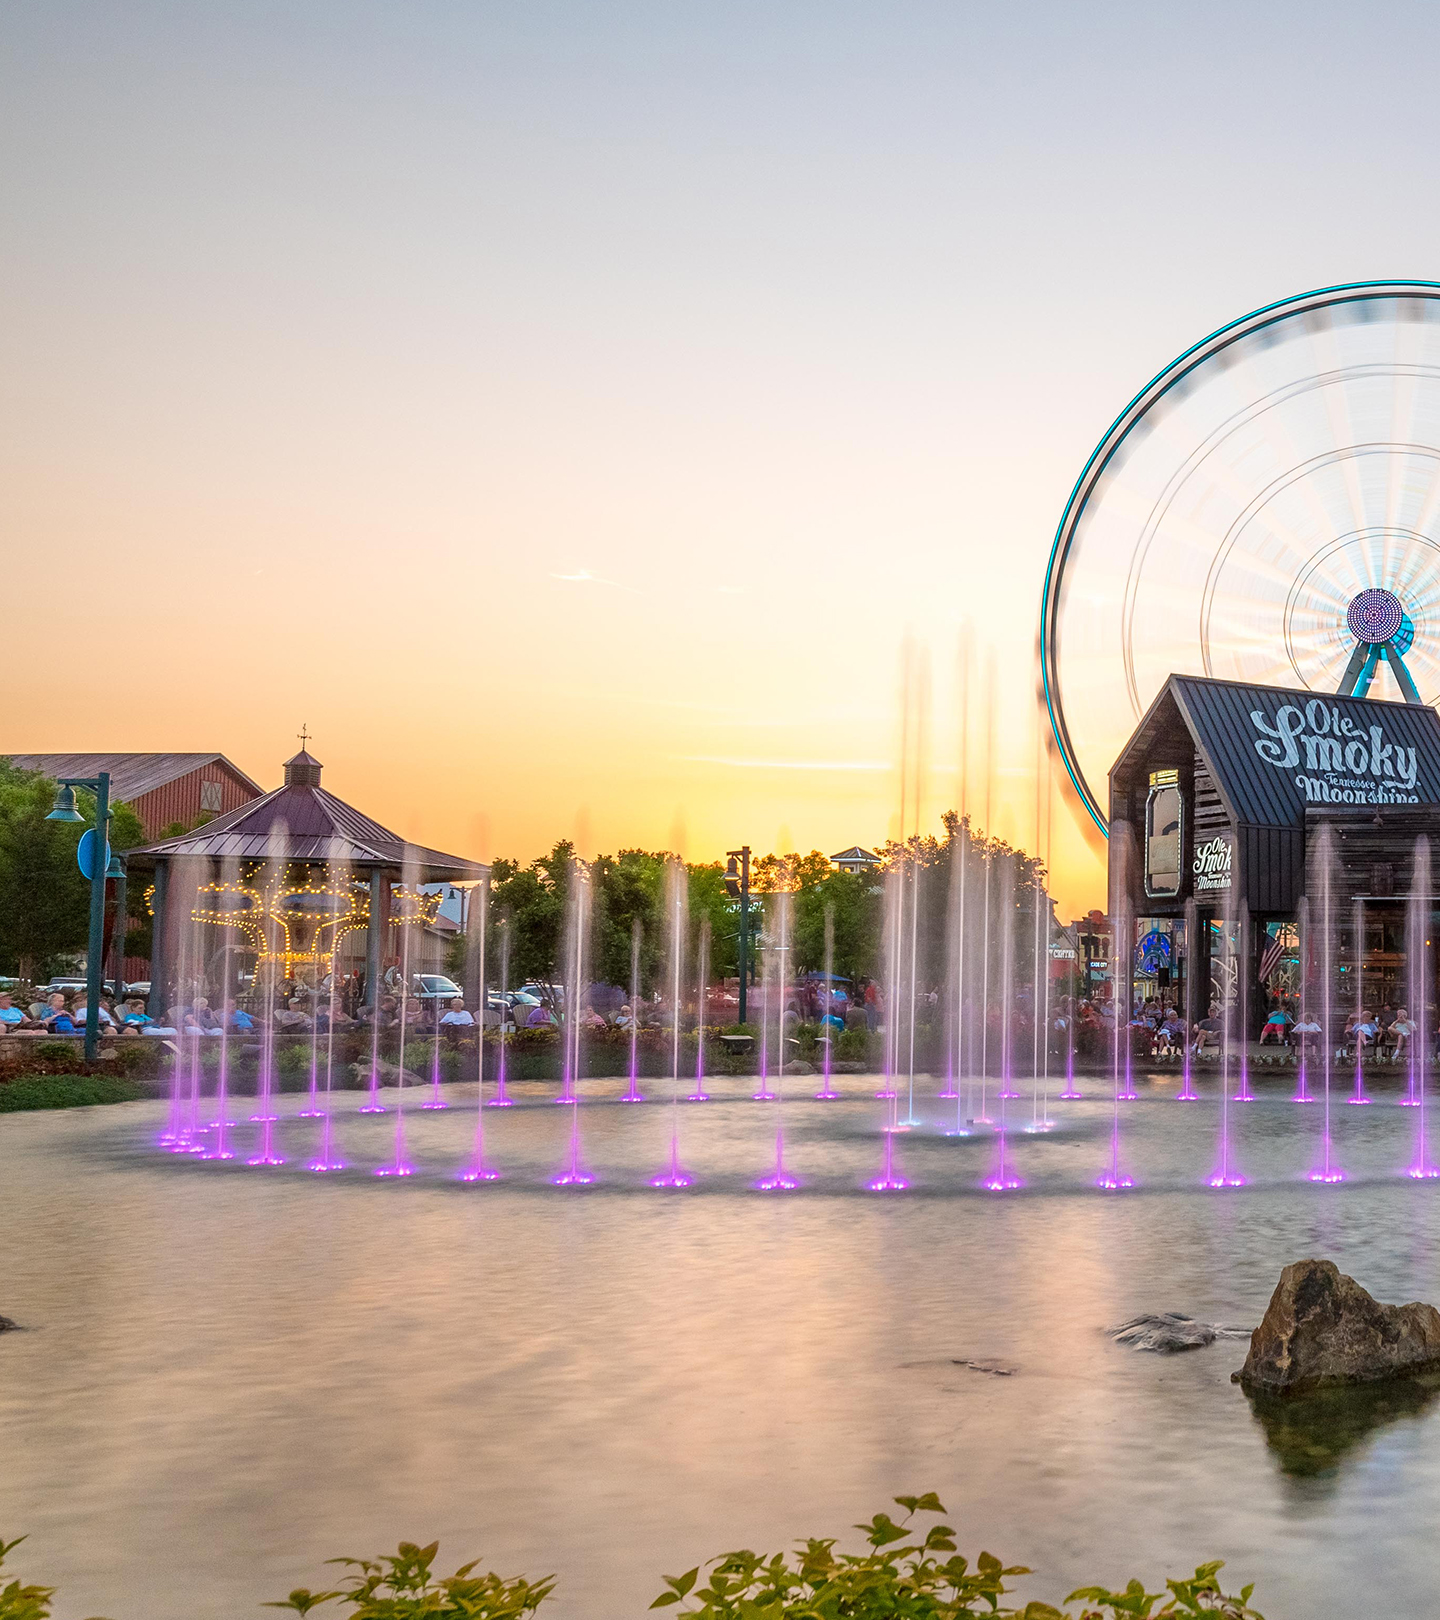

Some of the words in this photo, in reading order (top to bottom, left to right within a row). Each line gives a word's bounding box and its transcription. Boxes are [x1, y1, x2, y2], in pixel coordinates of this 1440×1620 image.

[1305, 699, 1369, 741] Ole
[1250, 705, 1418, 790] Smoky
[1295, 775, 1419, 804] Moonshine
[1324, 773, 1376, 789] Tennessee
[1193, 842, 1231, 874] Smok
[1212, 837, 1228, 854] Ole
[1197, 875, 1231, 889] Moonshin
